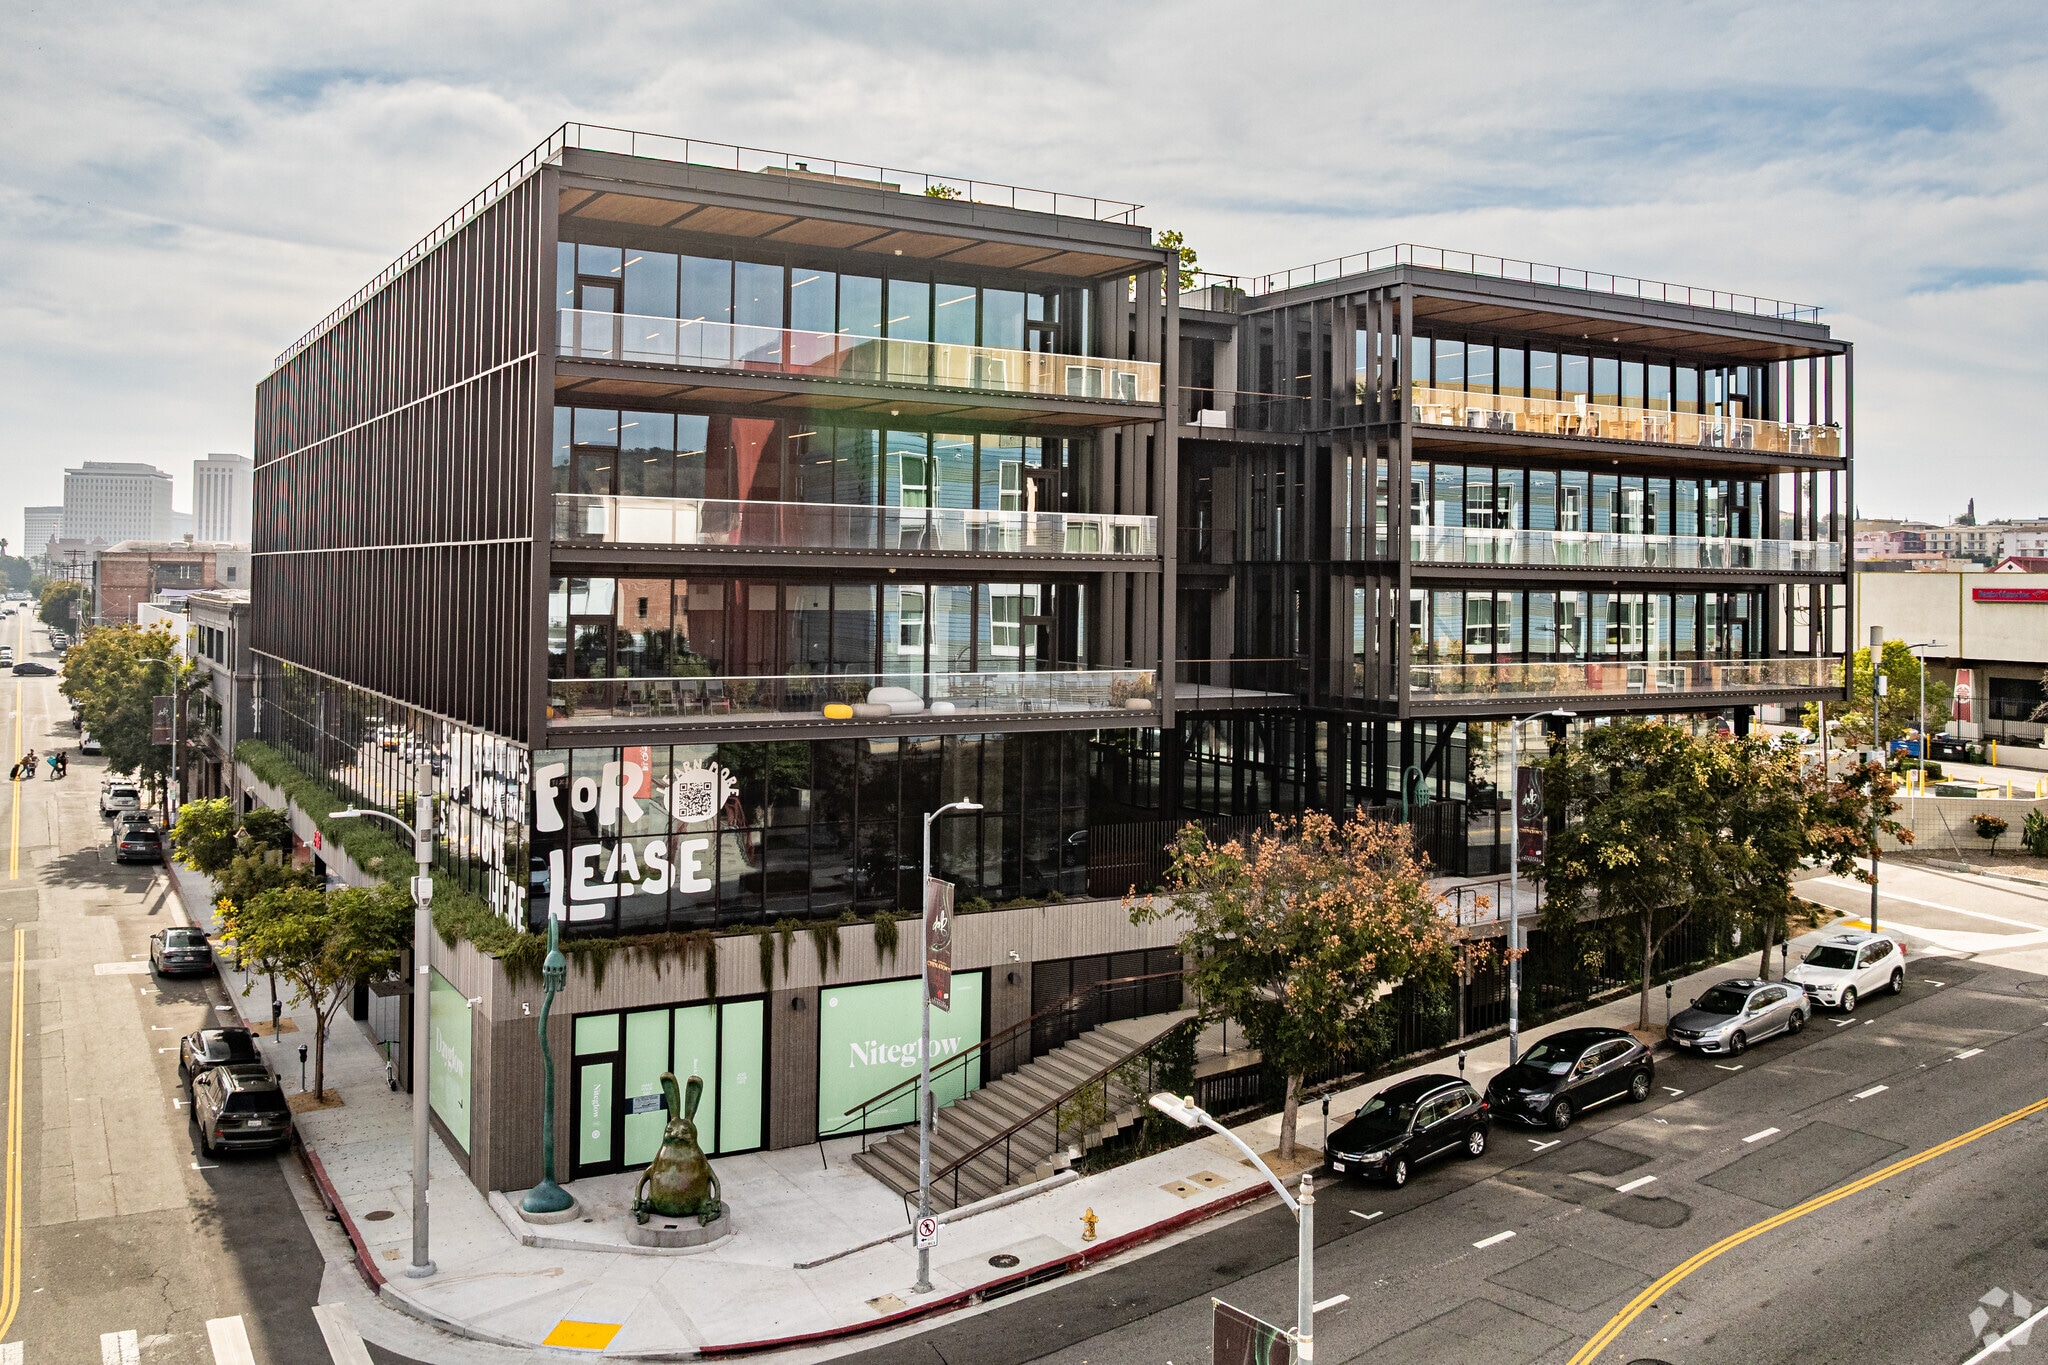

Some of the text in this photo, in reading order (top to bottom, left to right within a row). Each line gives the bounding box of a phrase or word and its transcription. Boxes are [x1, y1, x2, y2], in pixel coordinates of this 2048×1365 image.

[708, 761, 740, 797] MORE
[548, 838, 712, 922] LEASE
[849, 1036, 961, 1068] Niteglow
